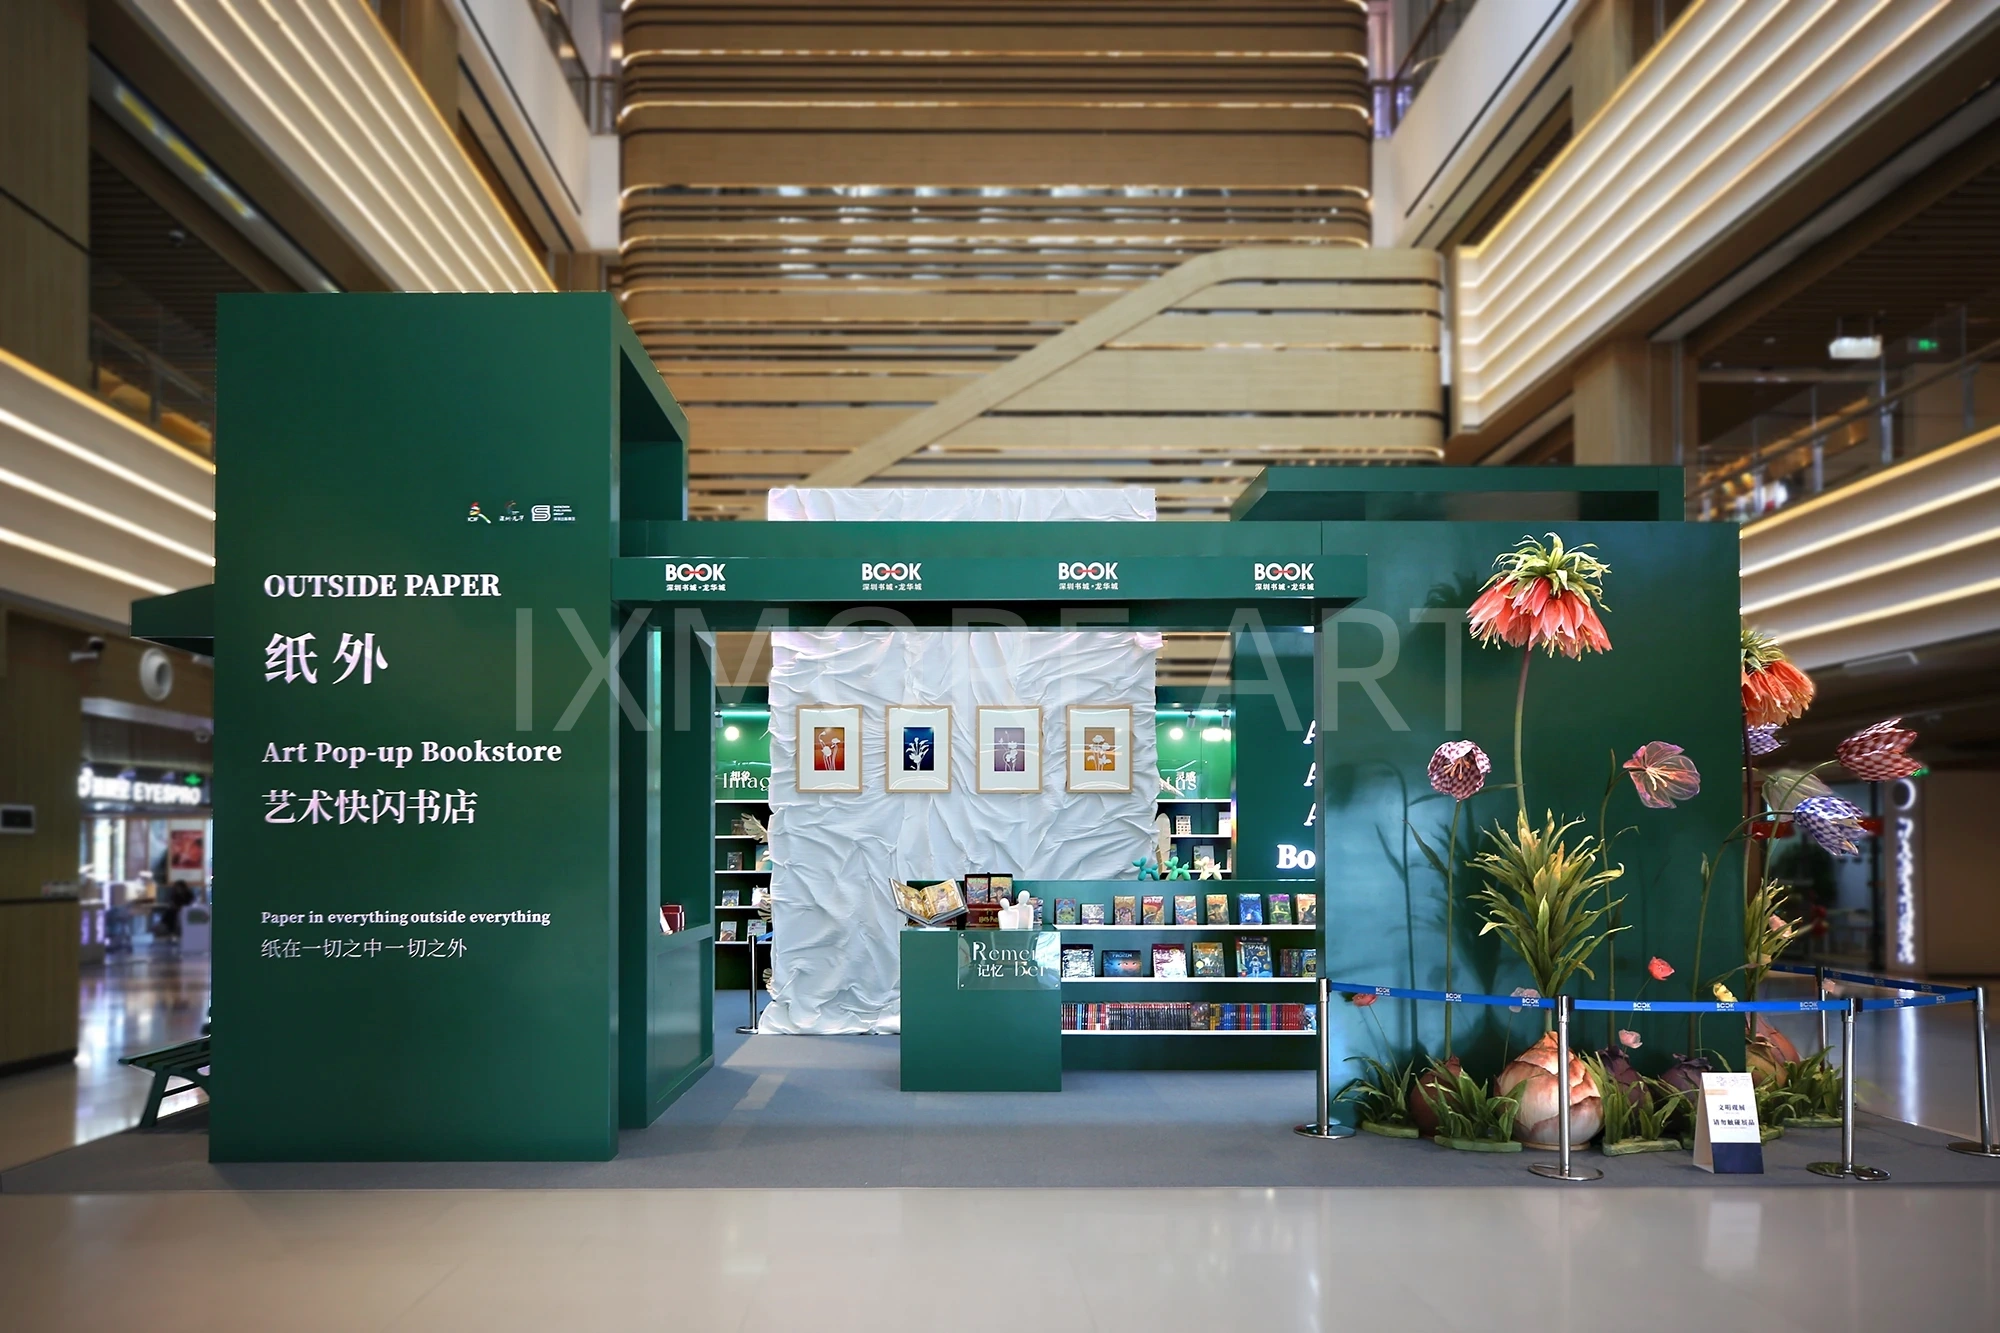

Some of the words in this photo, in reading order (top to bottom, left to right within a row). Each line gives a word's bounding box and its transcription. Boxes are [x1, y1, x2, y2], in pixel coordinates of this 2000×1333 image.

[665, 563, 726, 581] BOOK
[862, 562, 922, 581] BOOK
[1058, 562, 1119, 580] BOOK
[1254, 562, 1315, 581] BOOK
[264, 574, 397, 598] OUTSIDE
[404, 574, 501, 598] PAPER
[262, 742, 308, 763] Art
[314, 742, 413, 769] Pop-up
[421, 739, 562, 763] Bookstore
[261, 788, 478, 825] 艺术快闪书店
[261, 911, 305, 927] Paper
[308, 911, 324, 923] in
[327, 911, 409, 927] everything
[410, 910, 466, 924] outside
[469, 910, 551, 926] everything
[261, 938, 468, 959] 纸在一切之中一切之外
[977, 963, 1004, 977] 记忆
